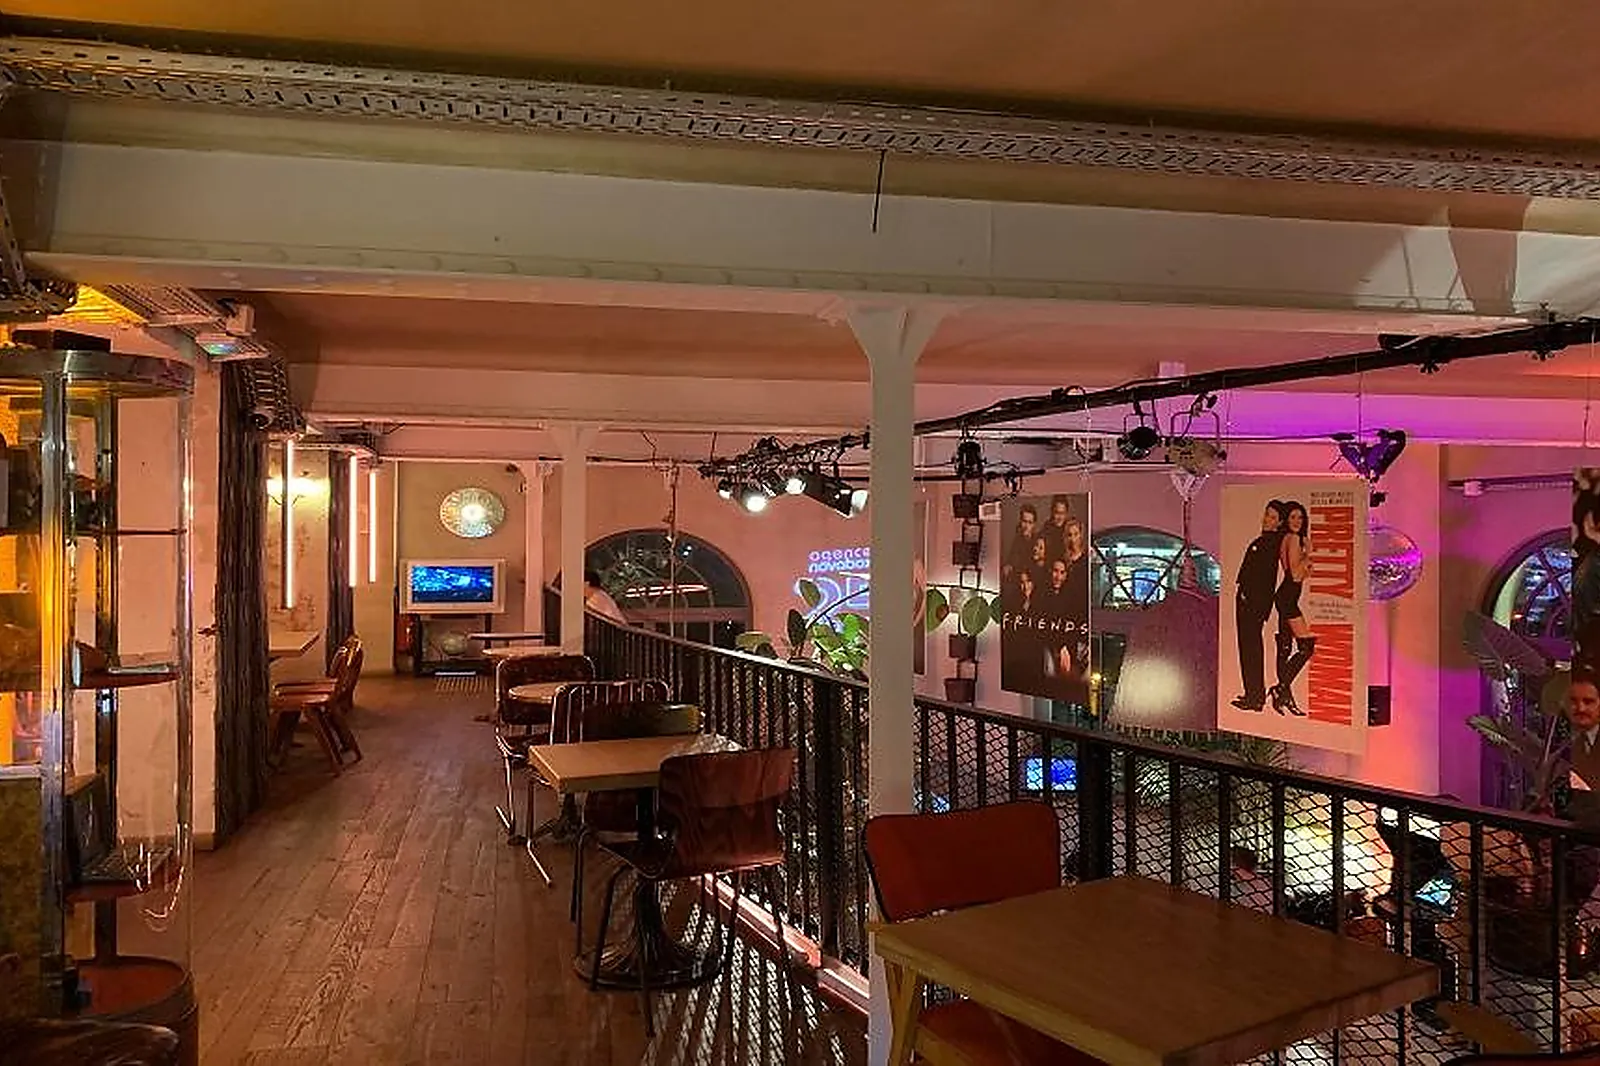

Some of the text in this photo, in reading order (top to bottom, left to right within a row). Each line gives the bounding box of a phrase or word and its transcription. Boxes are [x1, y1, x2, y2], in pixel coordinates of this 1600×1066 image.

[1310, 507, 1353, 598] PRETTY
[1002, 612, 1088, 635] FRIENDS
[1308, 624, 1353, 725] WOMAN
